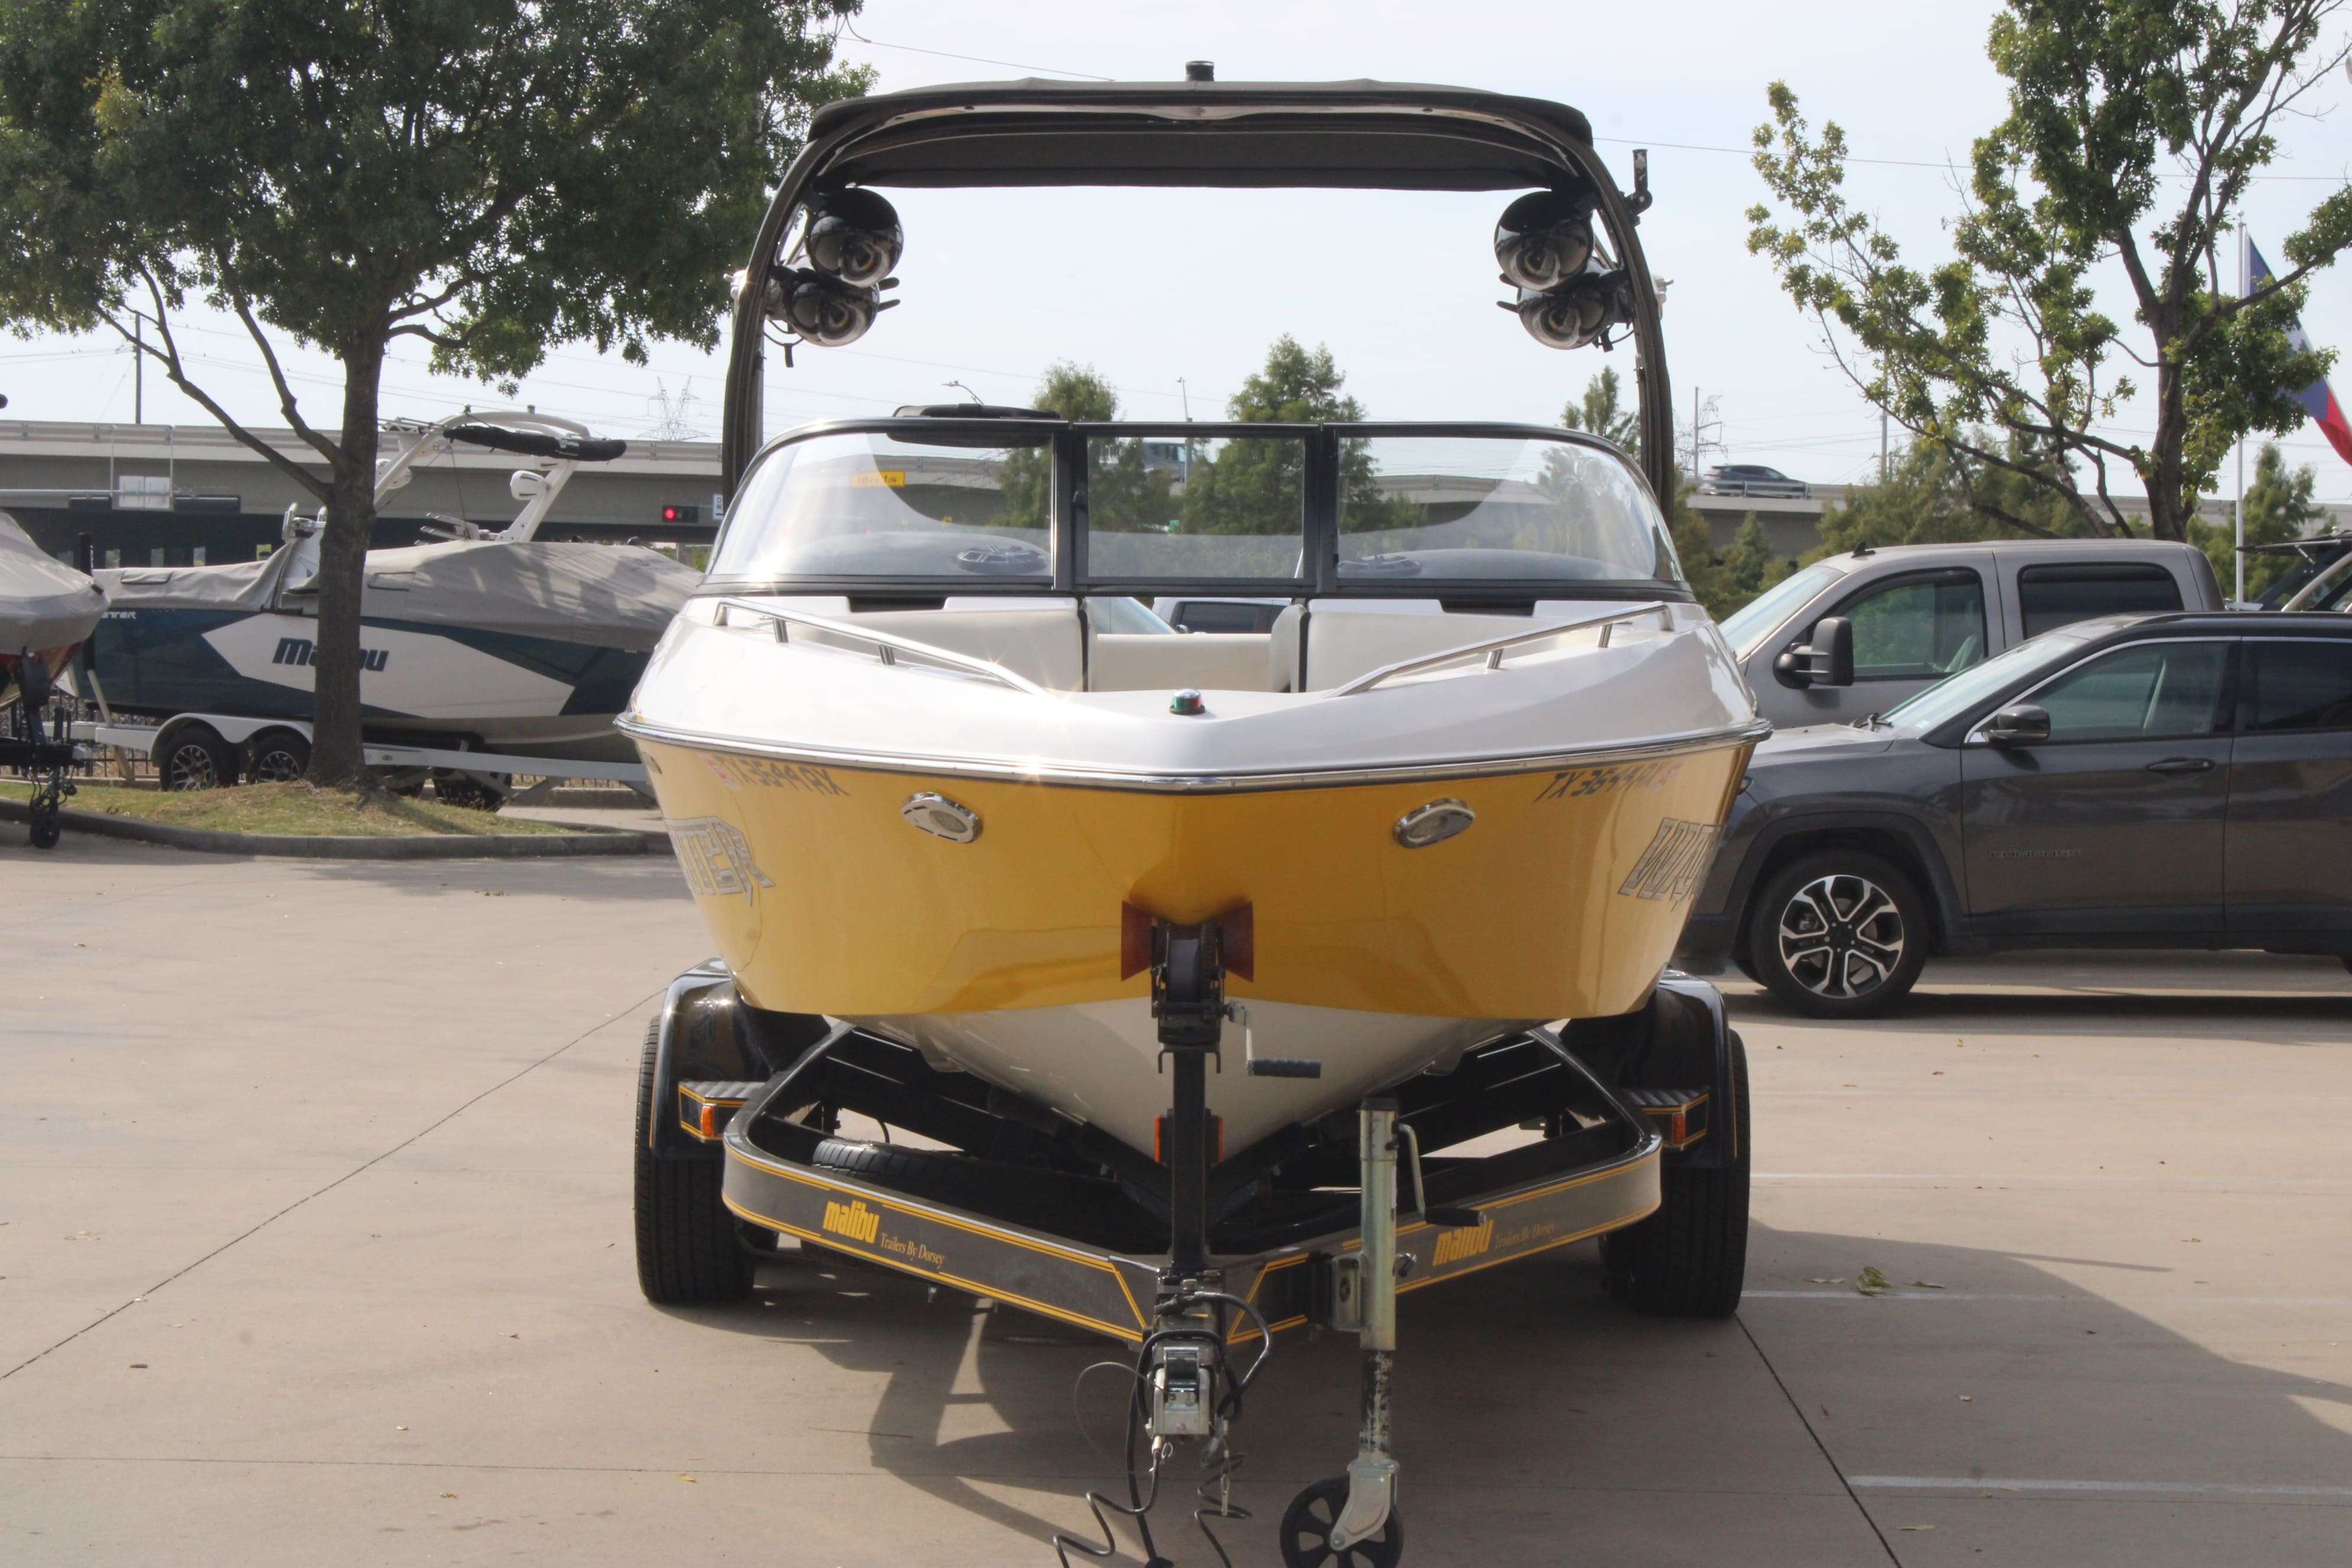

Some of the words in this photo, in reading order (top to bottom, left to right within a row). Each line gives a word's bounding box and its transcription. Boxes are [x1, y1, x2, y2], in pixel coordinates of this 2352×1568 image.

[822, 1200, 880, 1244] malibu
[880, 1232, 907, 1253] Trailers
[907, 1240, 917, 1261] By
[918, 1244, 945, 1269] Dorsey
